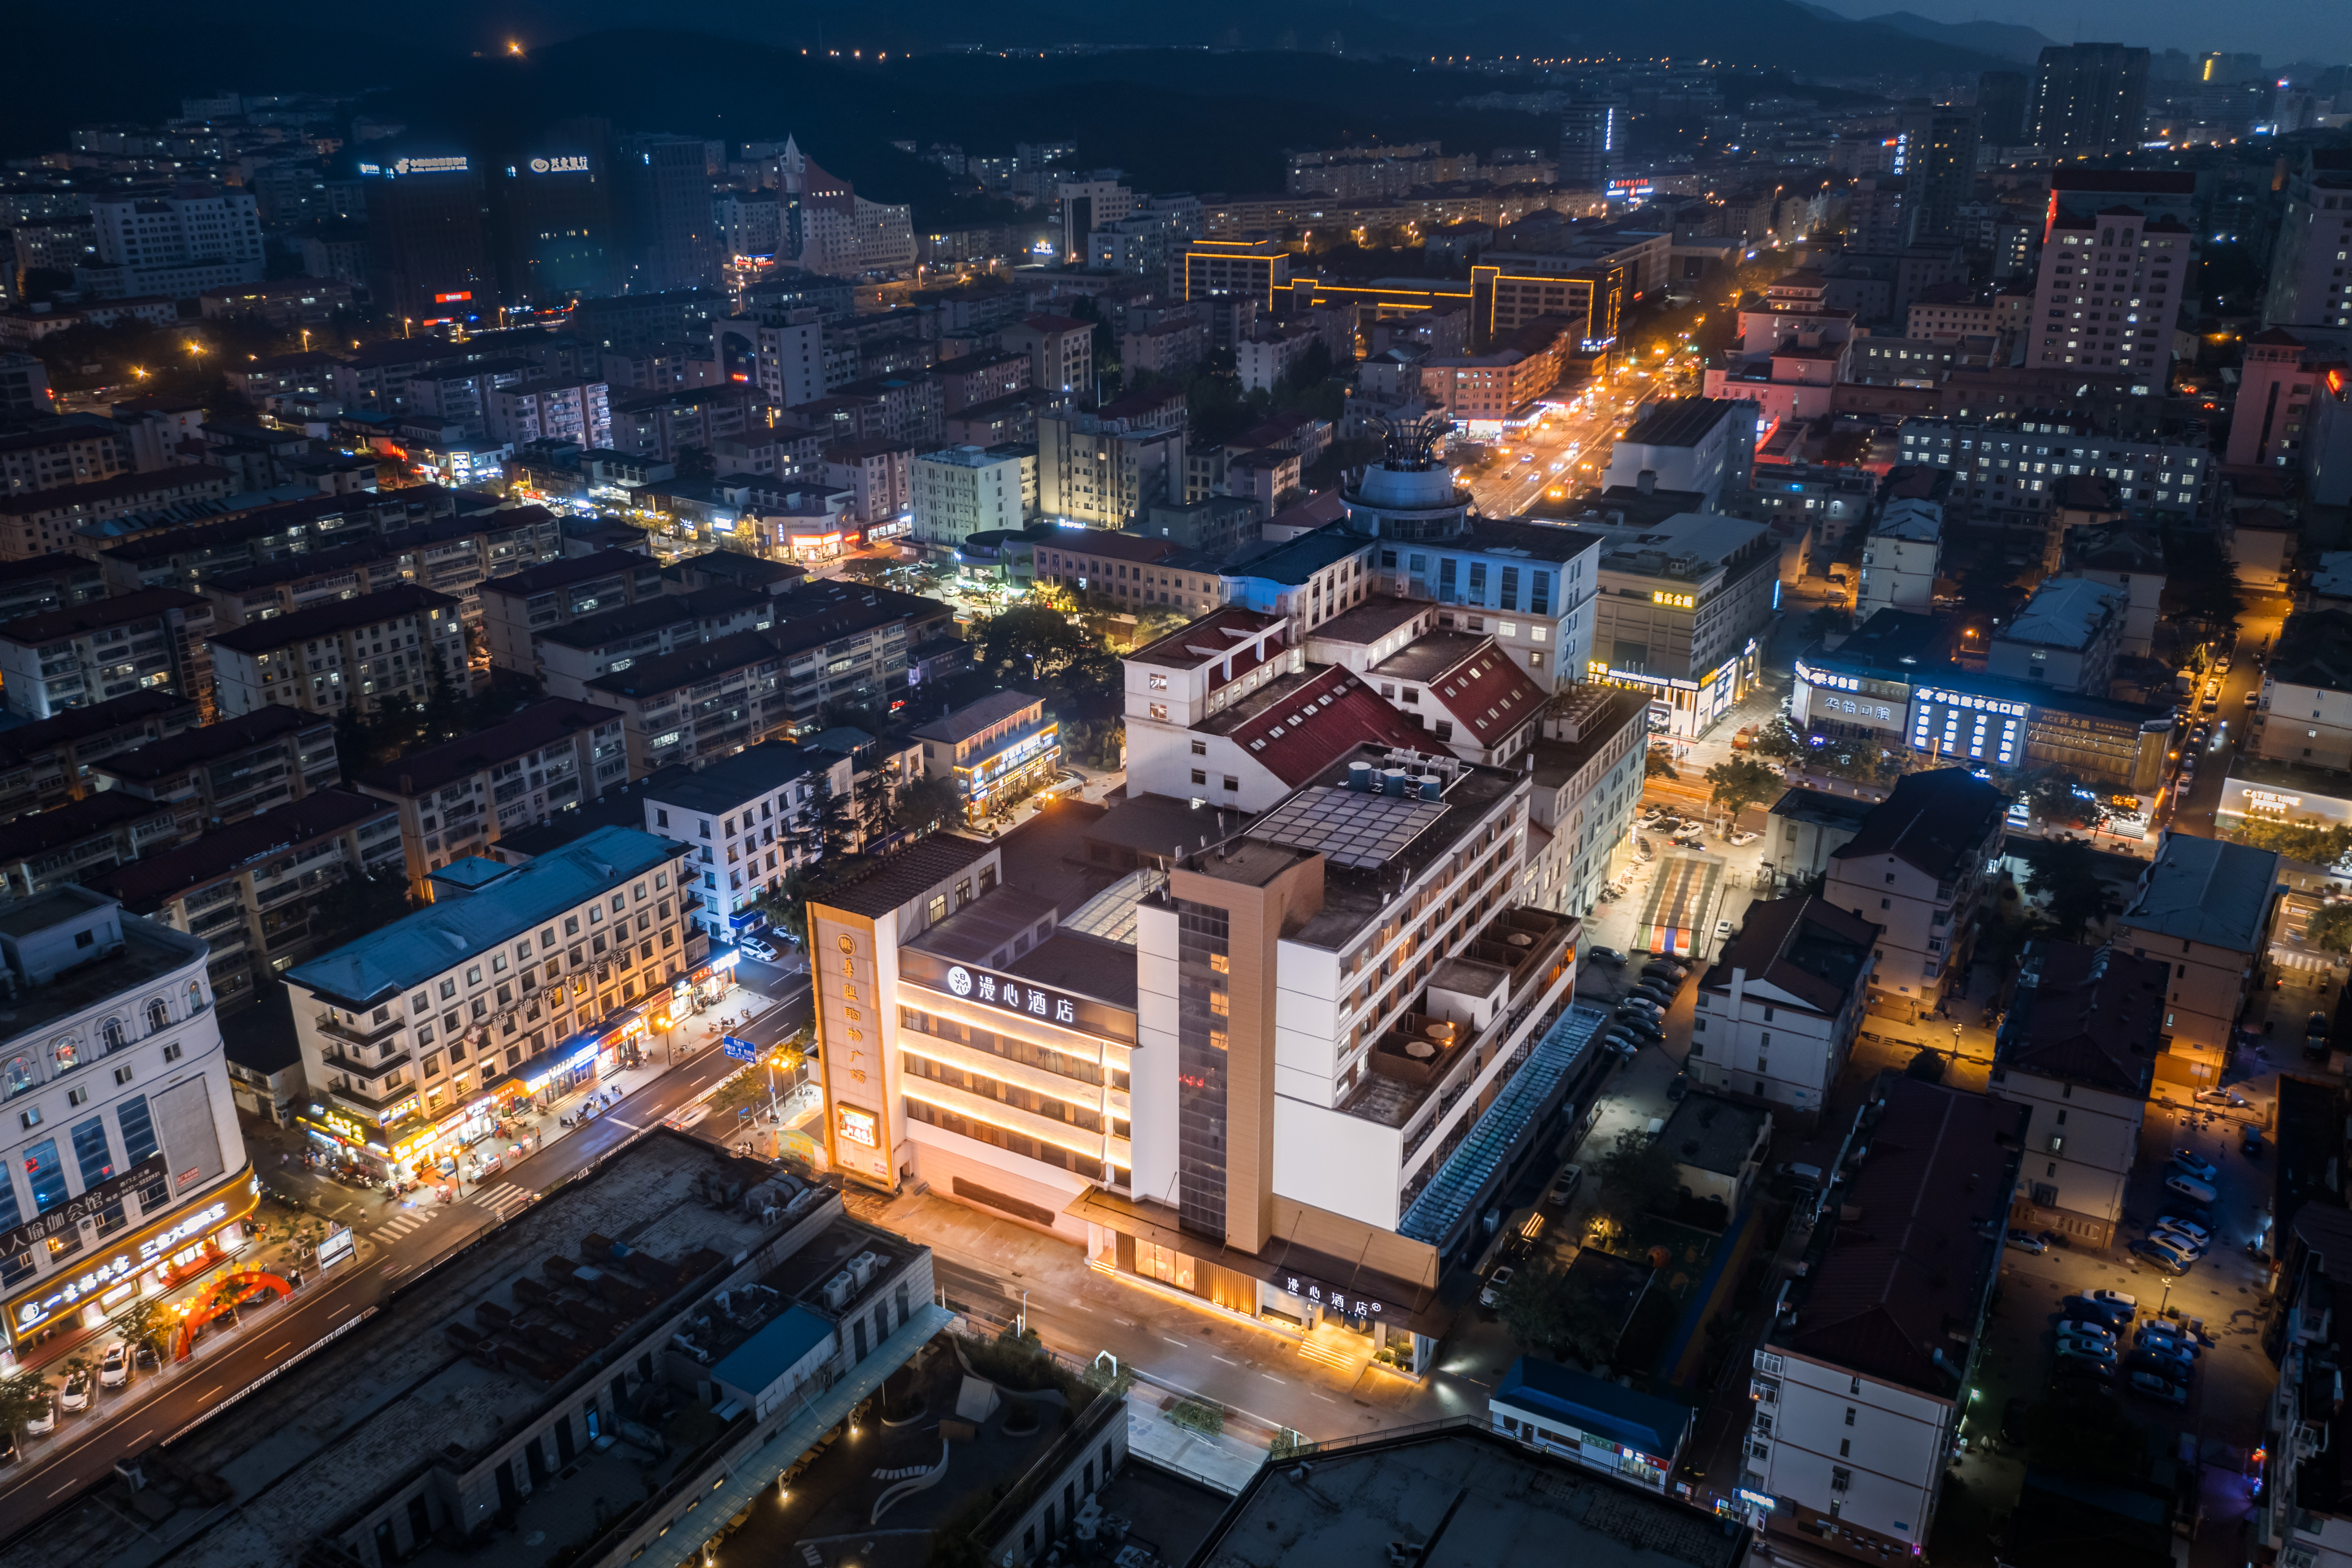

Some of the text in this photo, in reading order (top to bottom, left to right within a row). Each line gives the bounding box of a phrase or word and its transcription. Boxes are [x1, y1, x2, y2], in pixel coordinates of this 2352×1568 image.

[1894, 134, 1907, 175] 全季酒店
[1826, 697, 1890, 720] 华怡口腔
[2242, 789, 2300, 806] CATHERINE
[492, 947, 626, 1031] 福神医疗美容
[979, 975, 1073, 1023] 漫心酒店
[0, 1192, 103, 1259] 人瑜伽会馆
[1287, 1277, 1368, 1316] 漫心酒店
[1334, 1306, 1364, 1319] HOTEL
